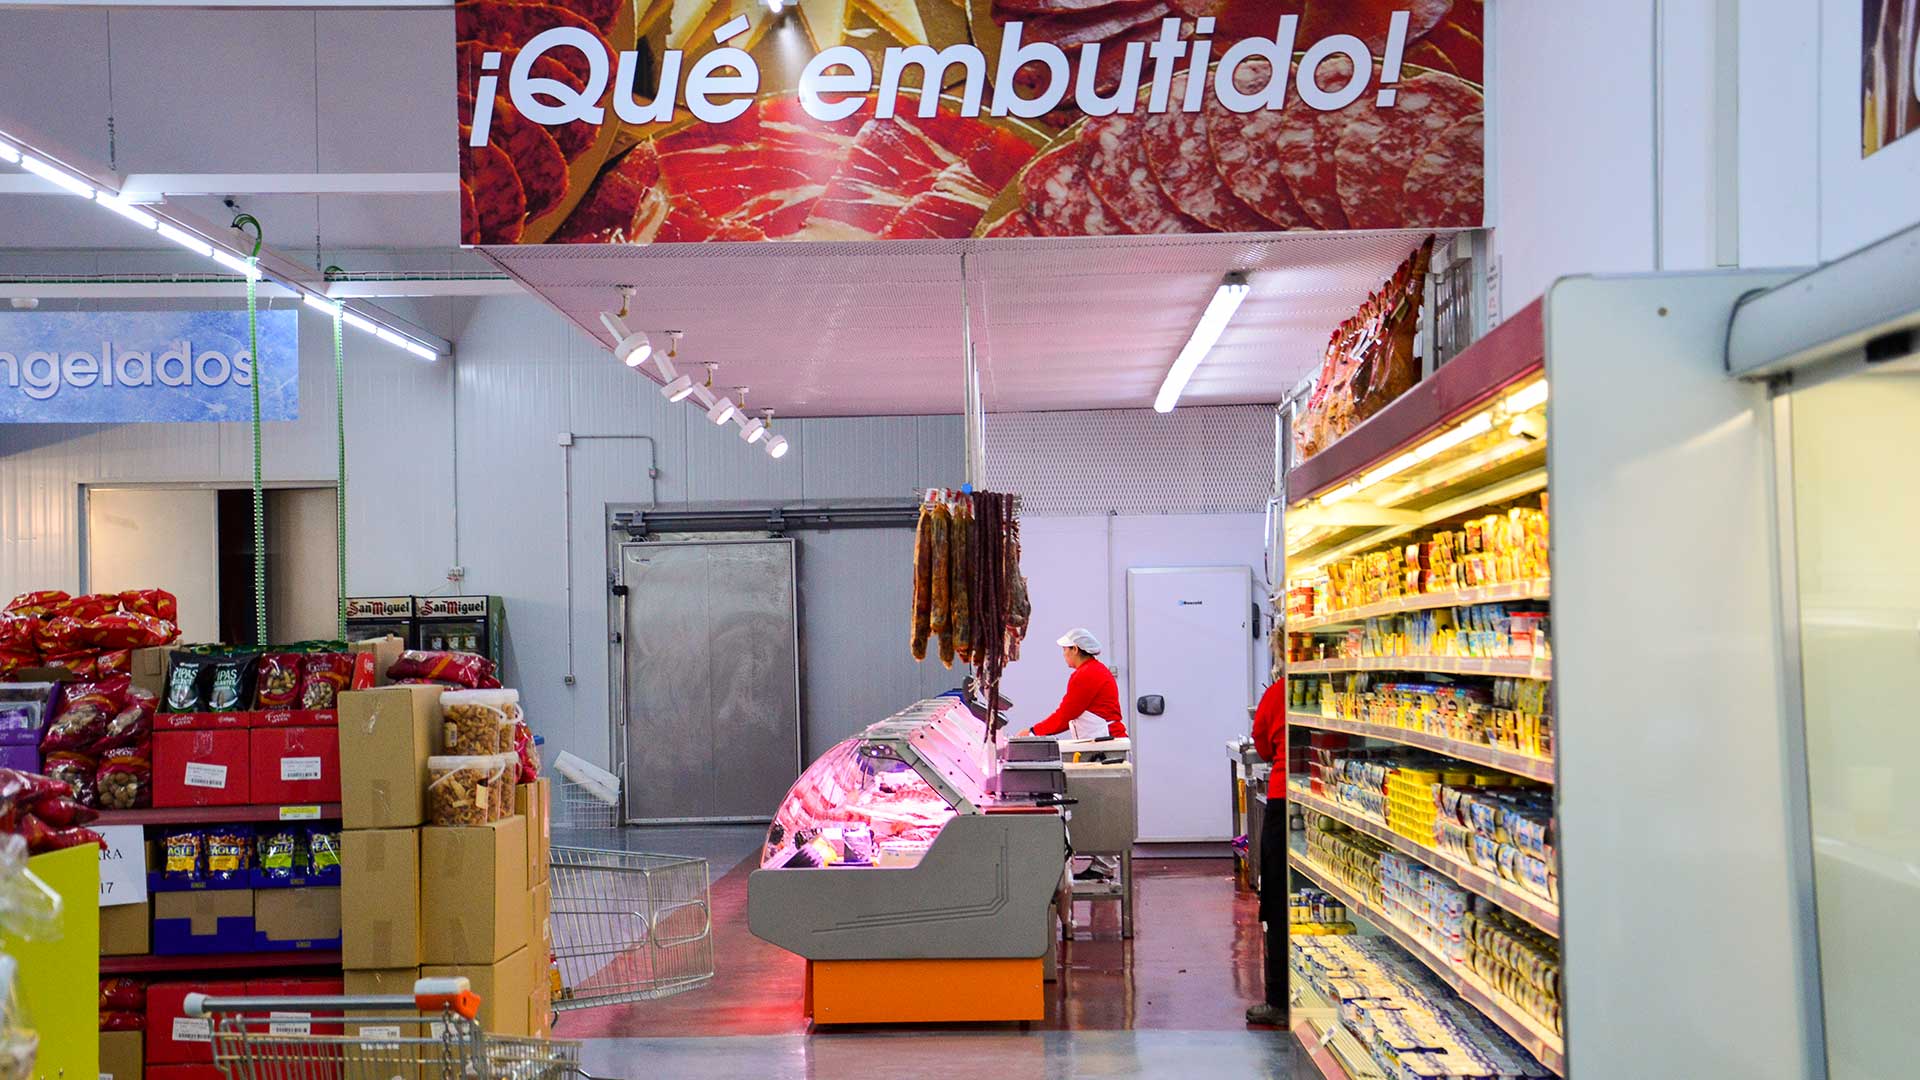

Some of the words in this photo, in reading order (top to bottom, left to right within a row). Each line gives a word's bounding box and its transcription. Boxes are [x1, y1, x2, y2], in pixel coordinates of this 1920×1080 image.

[469, 14, 760, 147] ¡Qué
[798, 10, 1410, 122] embutido!
[98, 848, 123, 861] RA
